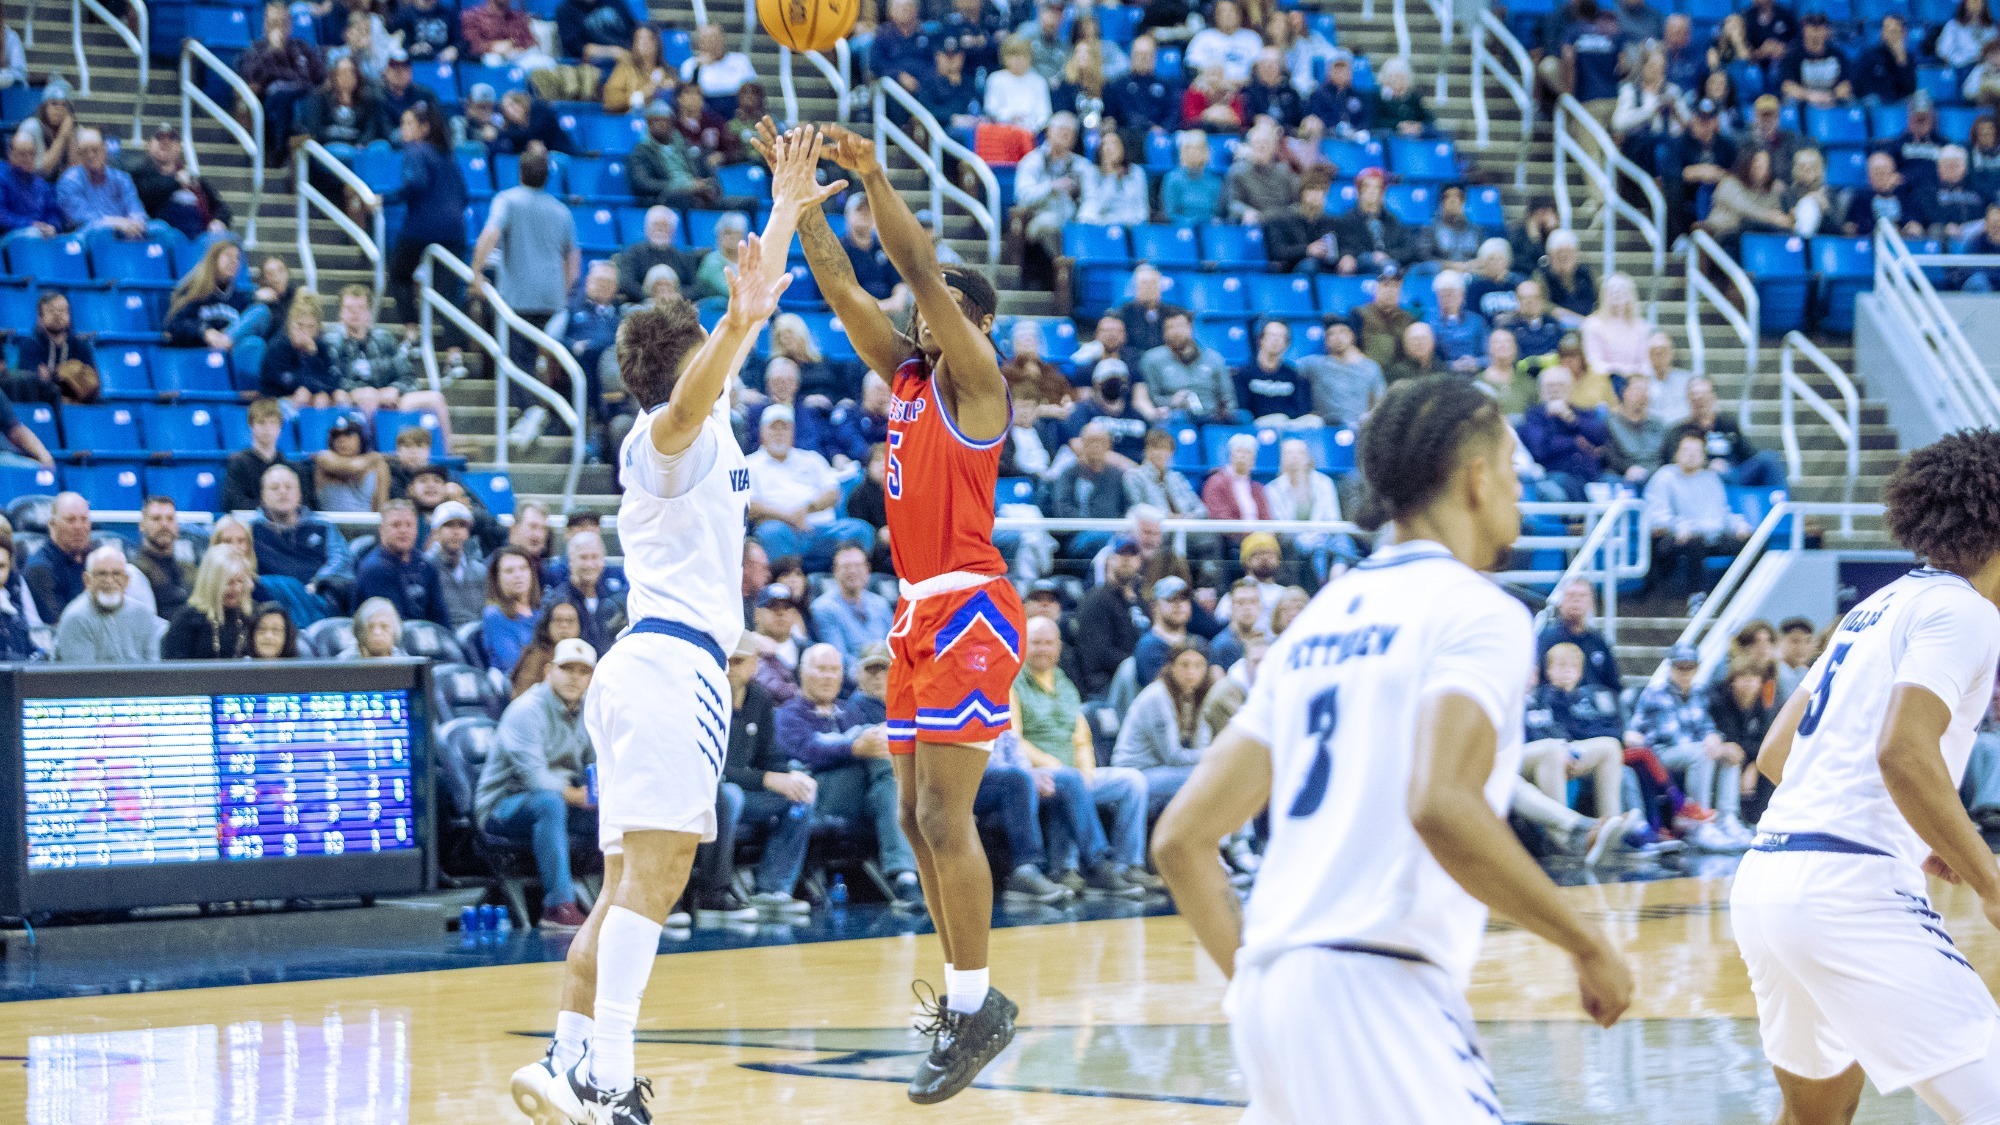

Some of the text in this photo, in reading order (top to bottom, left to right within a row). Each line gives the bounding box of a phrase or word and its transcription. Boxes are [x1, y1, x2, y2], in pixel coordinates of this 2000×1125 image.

[887, 430, 903, 499] 5
[1797, 642, 1854, 738] 5
[1286, 682, 1341, 819] 3
